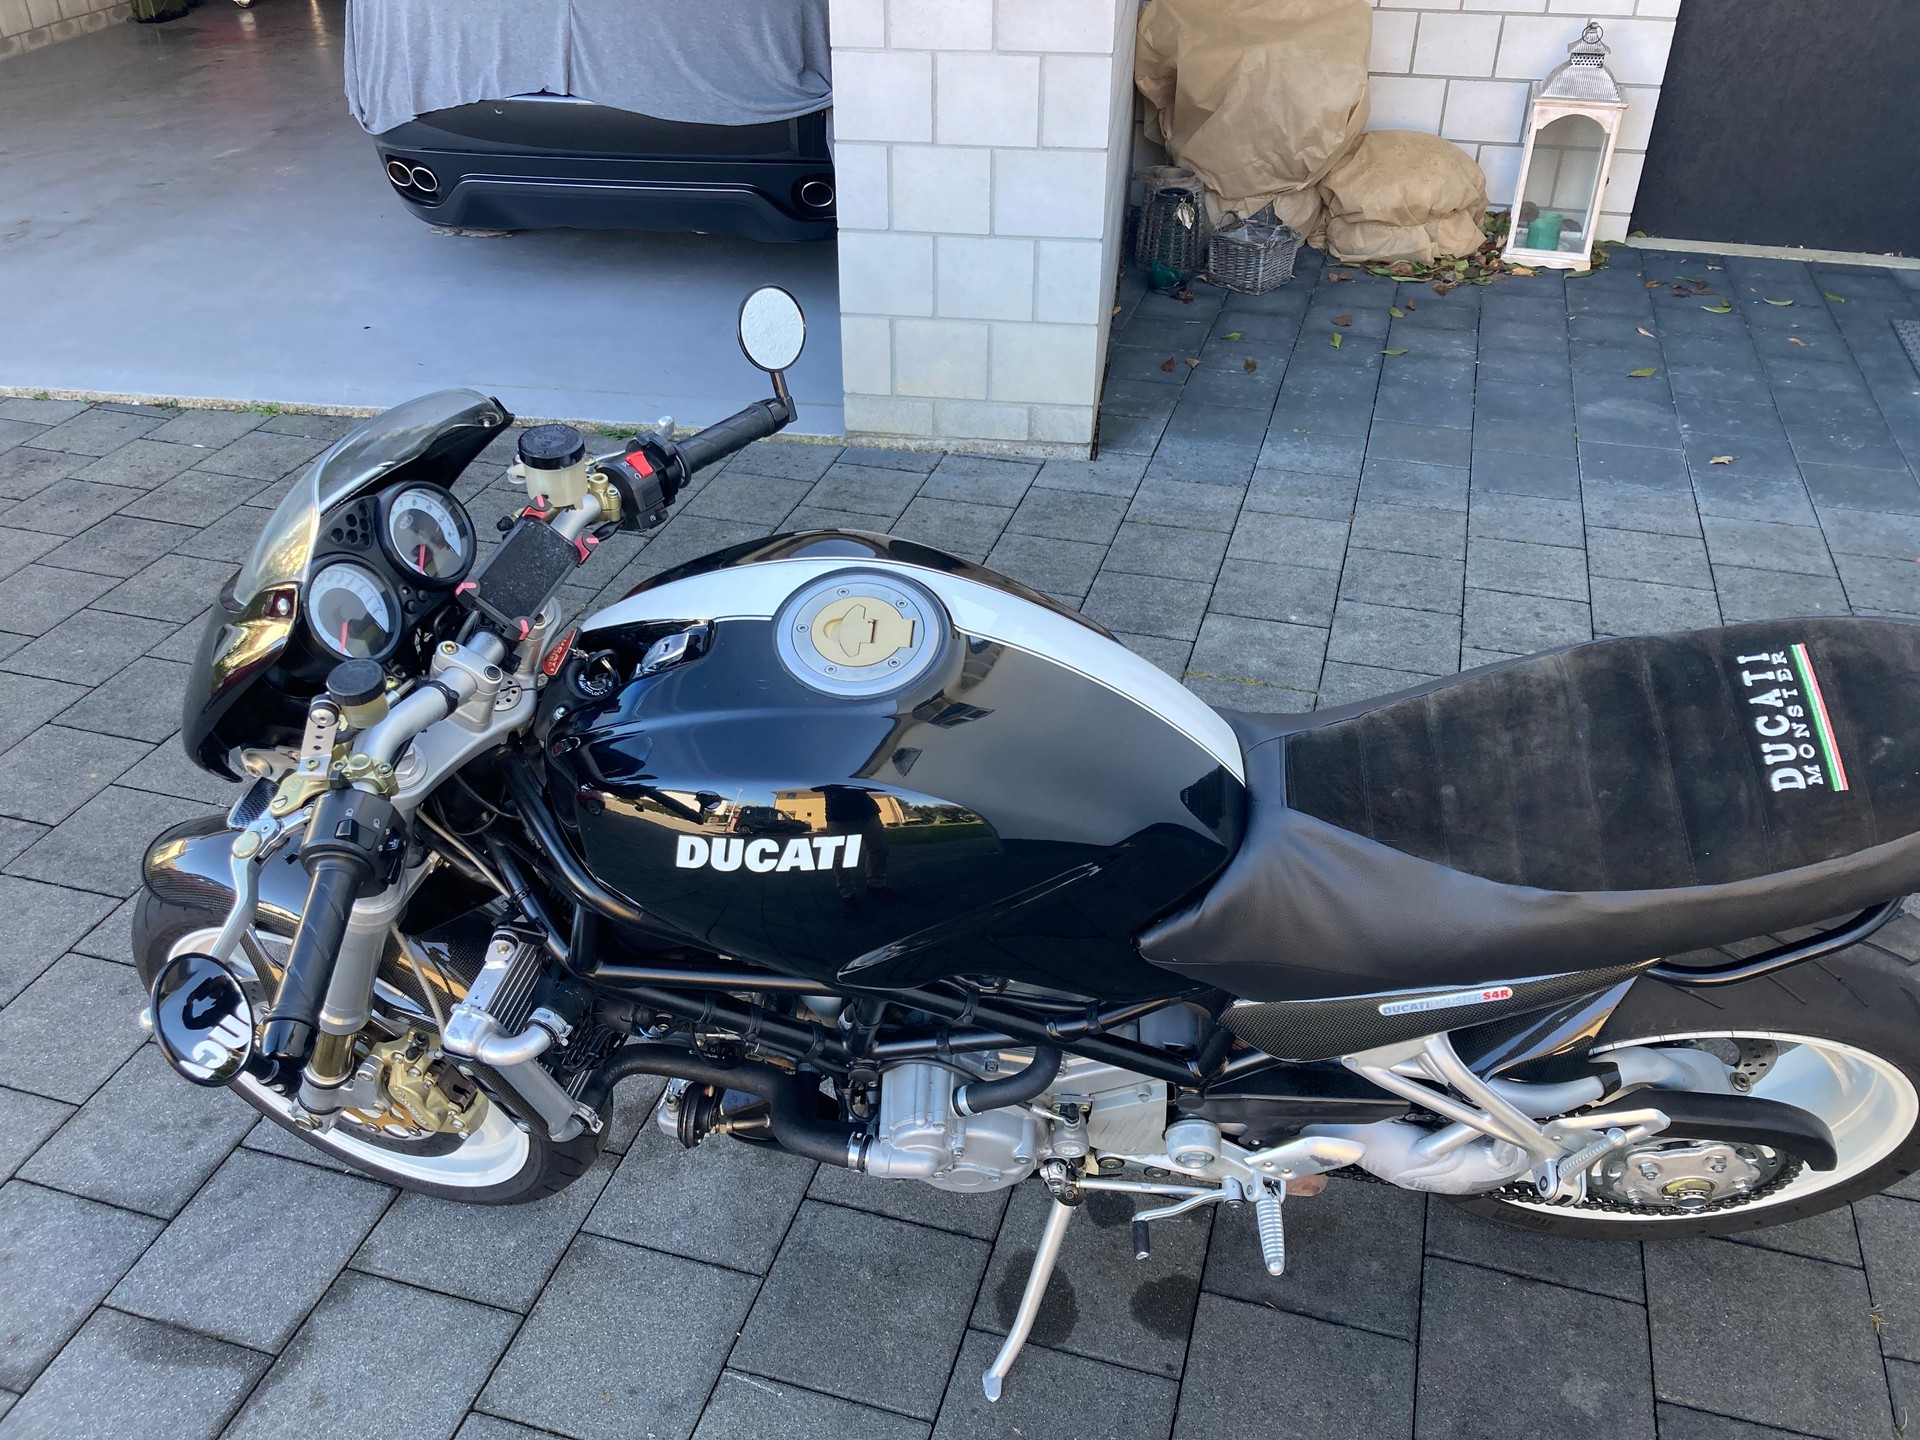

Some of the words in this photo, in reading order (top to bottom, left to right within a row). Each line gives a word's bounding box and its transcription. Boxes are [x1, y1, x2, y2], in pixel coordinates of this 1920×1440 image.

[1736, 652, 1806, 792] DUCATI
[1771, 651, 1824, 785] MONSTER
[676, 834, 862, 873] DUCATI
[1483, 989, 1510, 1001] S4R
